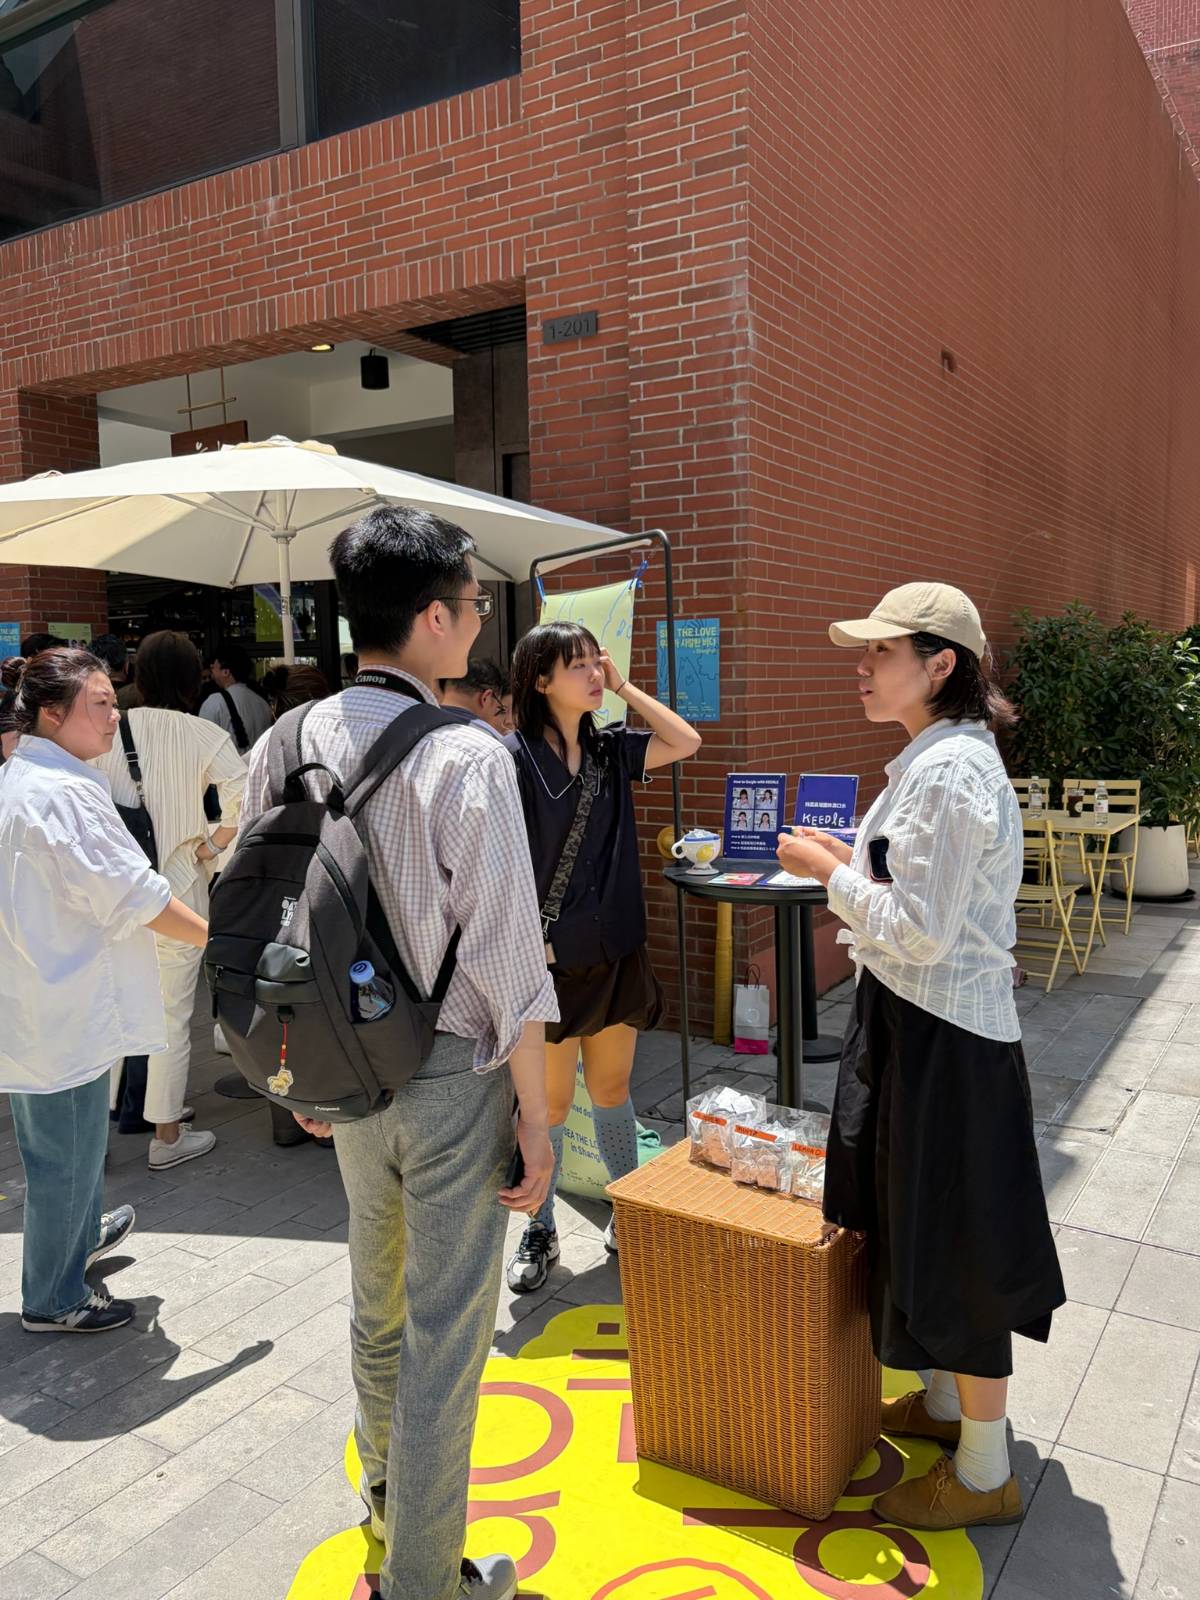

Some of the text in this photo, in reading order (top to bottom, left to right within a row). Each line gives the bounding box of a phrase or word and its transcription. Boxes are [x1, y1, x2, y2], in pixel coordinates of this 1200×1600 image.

[549, 318, 590, 339] 1-201
[694, 626, 717, 637] LOVE
[355, 674, 387, 684] Canon
